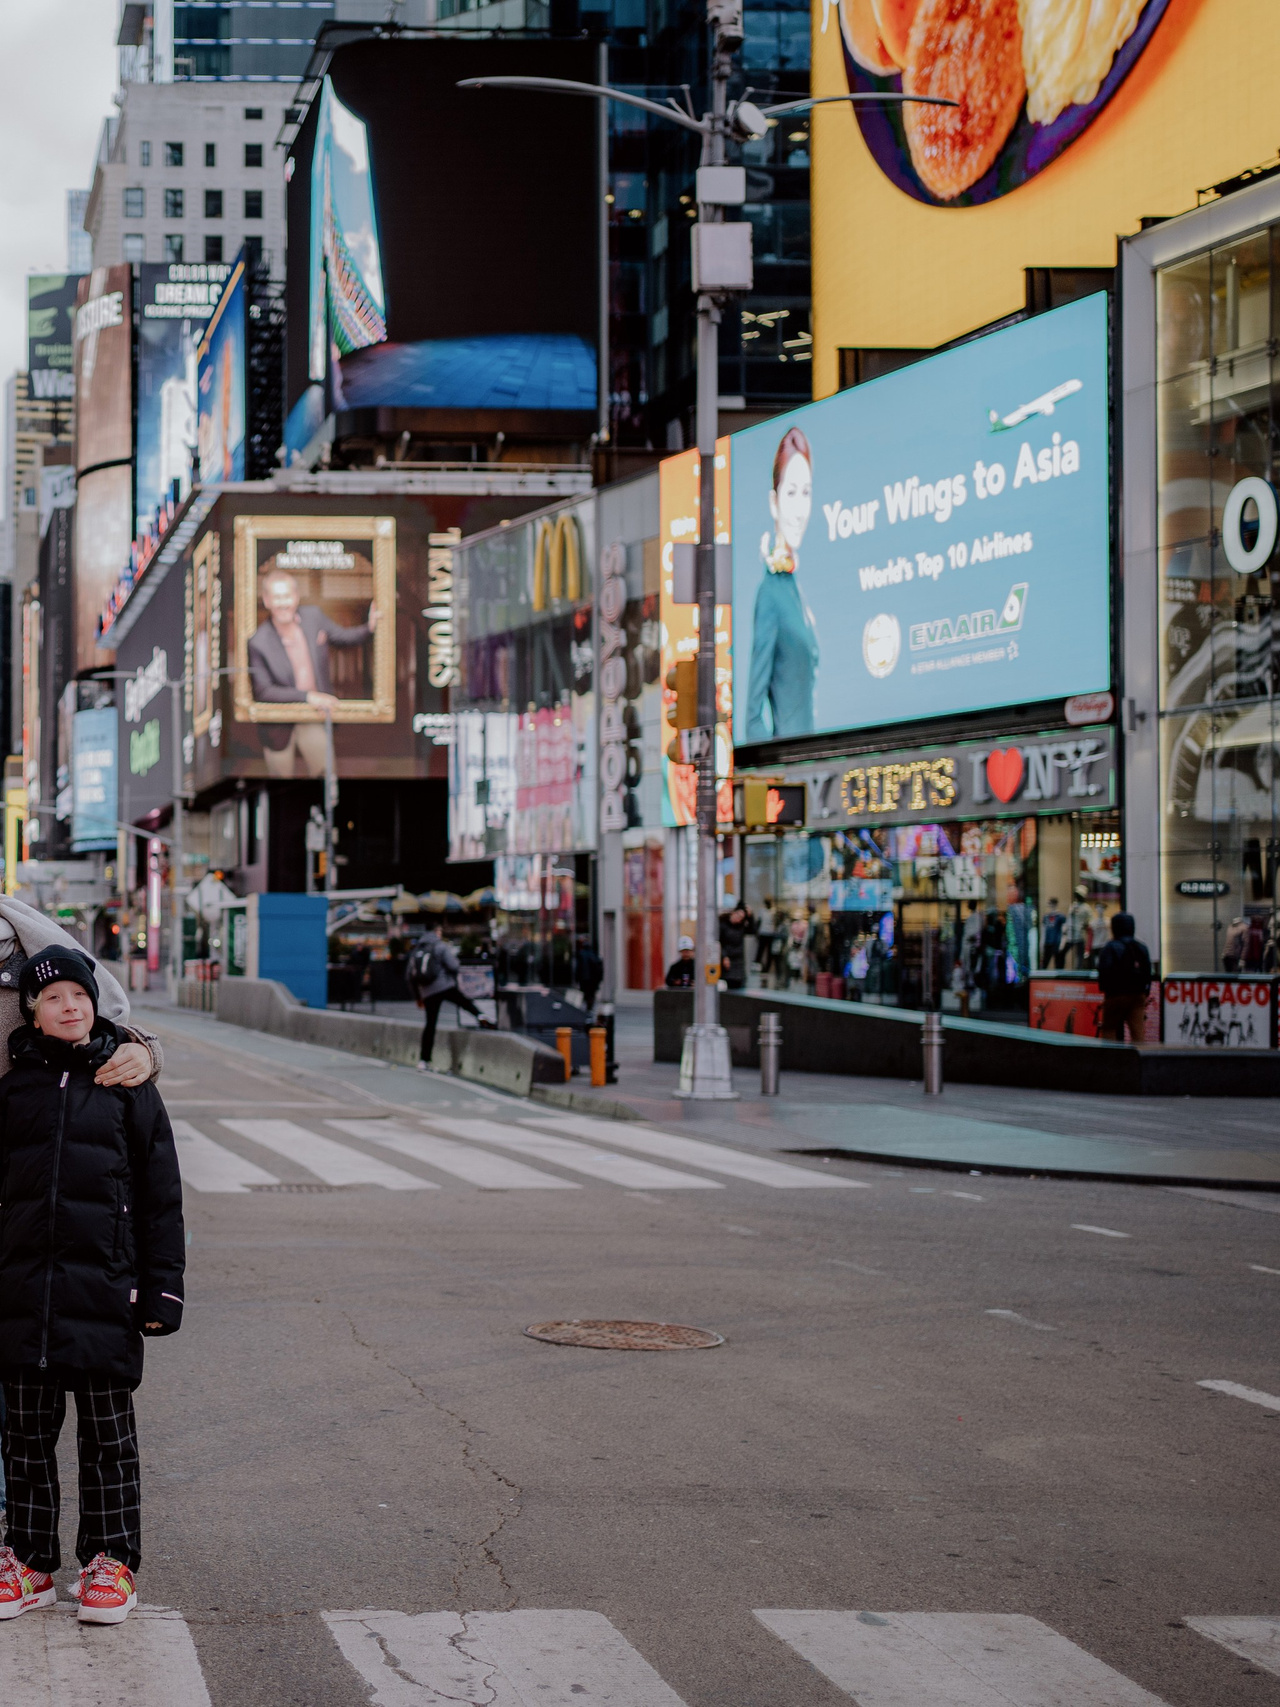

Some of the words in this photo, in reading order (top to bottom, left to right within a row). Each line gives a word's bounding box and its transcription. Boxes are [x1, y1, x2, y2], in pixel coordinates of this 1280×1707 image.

[823, 497, 880, 541] Your
[884, 474, 967, 524] Wings
[972, 460, 1006, 499] to
[1013, 432, 1080, 489] Asia
[858, 556, 914, 592] World's
[915, 552, 944, 581] Top
[947, 543, 968, 570] 10
[970, 531, 1033, 564] Airlines
[841, 756, 956, 816] GIFTS
[1164, 982, 1270, 1007] CHICAGO
